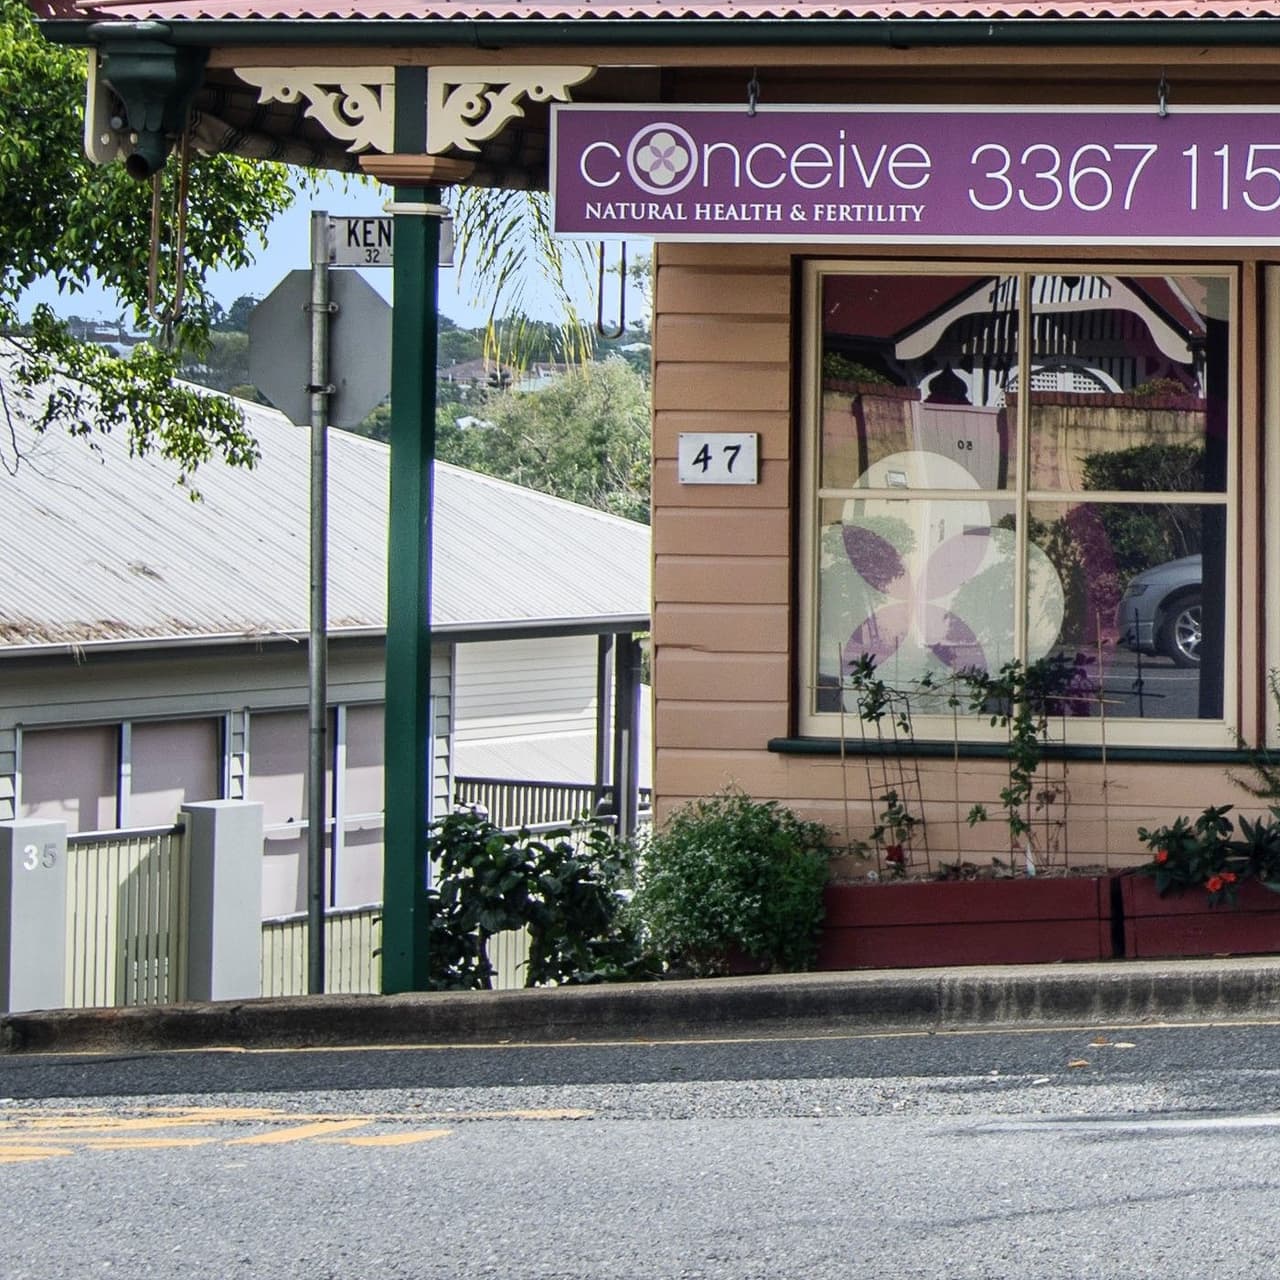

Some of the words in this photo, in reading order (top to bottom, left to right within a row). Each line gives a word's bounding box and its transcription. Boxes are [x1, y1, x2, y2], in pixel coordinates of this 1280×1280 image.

[968, 143, 1159, 211] 3367
[585, 202, 688, 221] NATURAL
[695, 203, 782, 222] HEALTH
[790, 205, 807, 221] &
[814, 204, 925, 222] FERTILITY
[347, 220, 392, 248] KEN
[365, 249, 380, 263] 32
[692, 443, 742, 474] 47
[23, 842, 57, 871] 35
